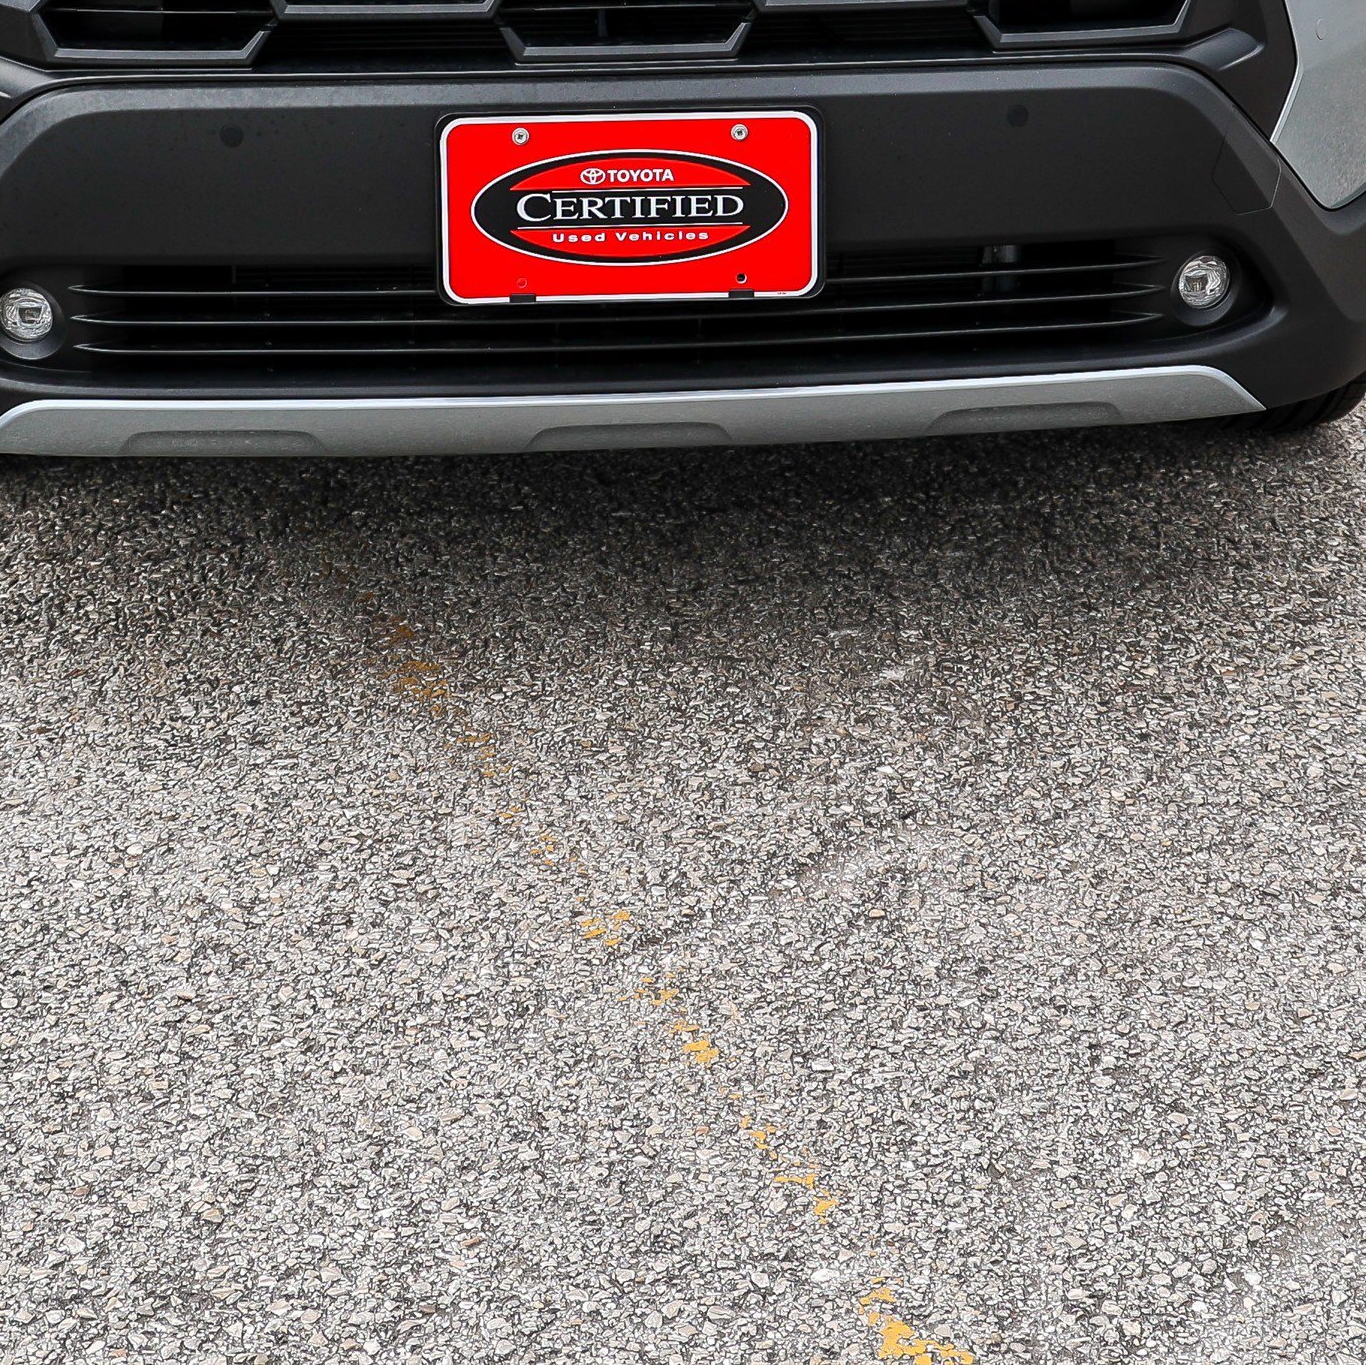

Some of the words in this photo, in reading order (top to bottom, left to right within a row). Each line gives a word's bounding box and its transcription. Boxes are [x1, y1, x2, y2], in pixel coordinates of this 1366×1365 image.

[607, 168, 674, 183] TOYOTA
[516, 192, 744, 223] CERTIFIED
[552, 232, 606, 243] Used
[615, 230, 709, 242] Vehicles
